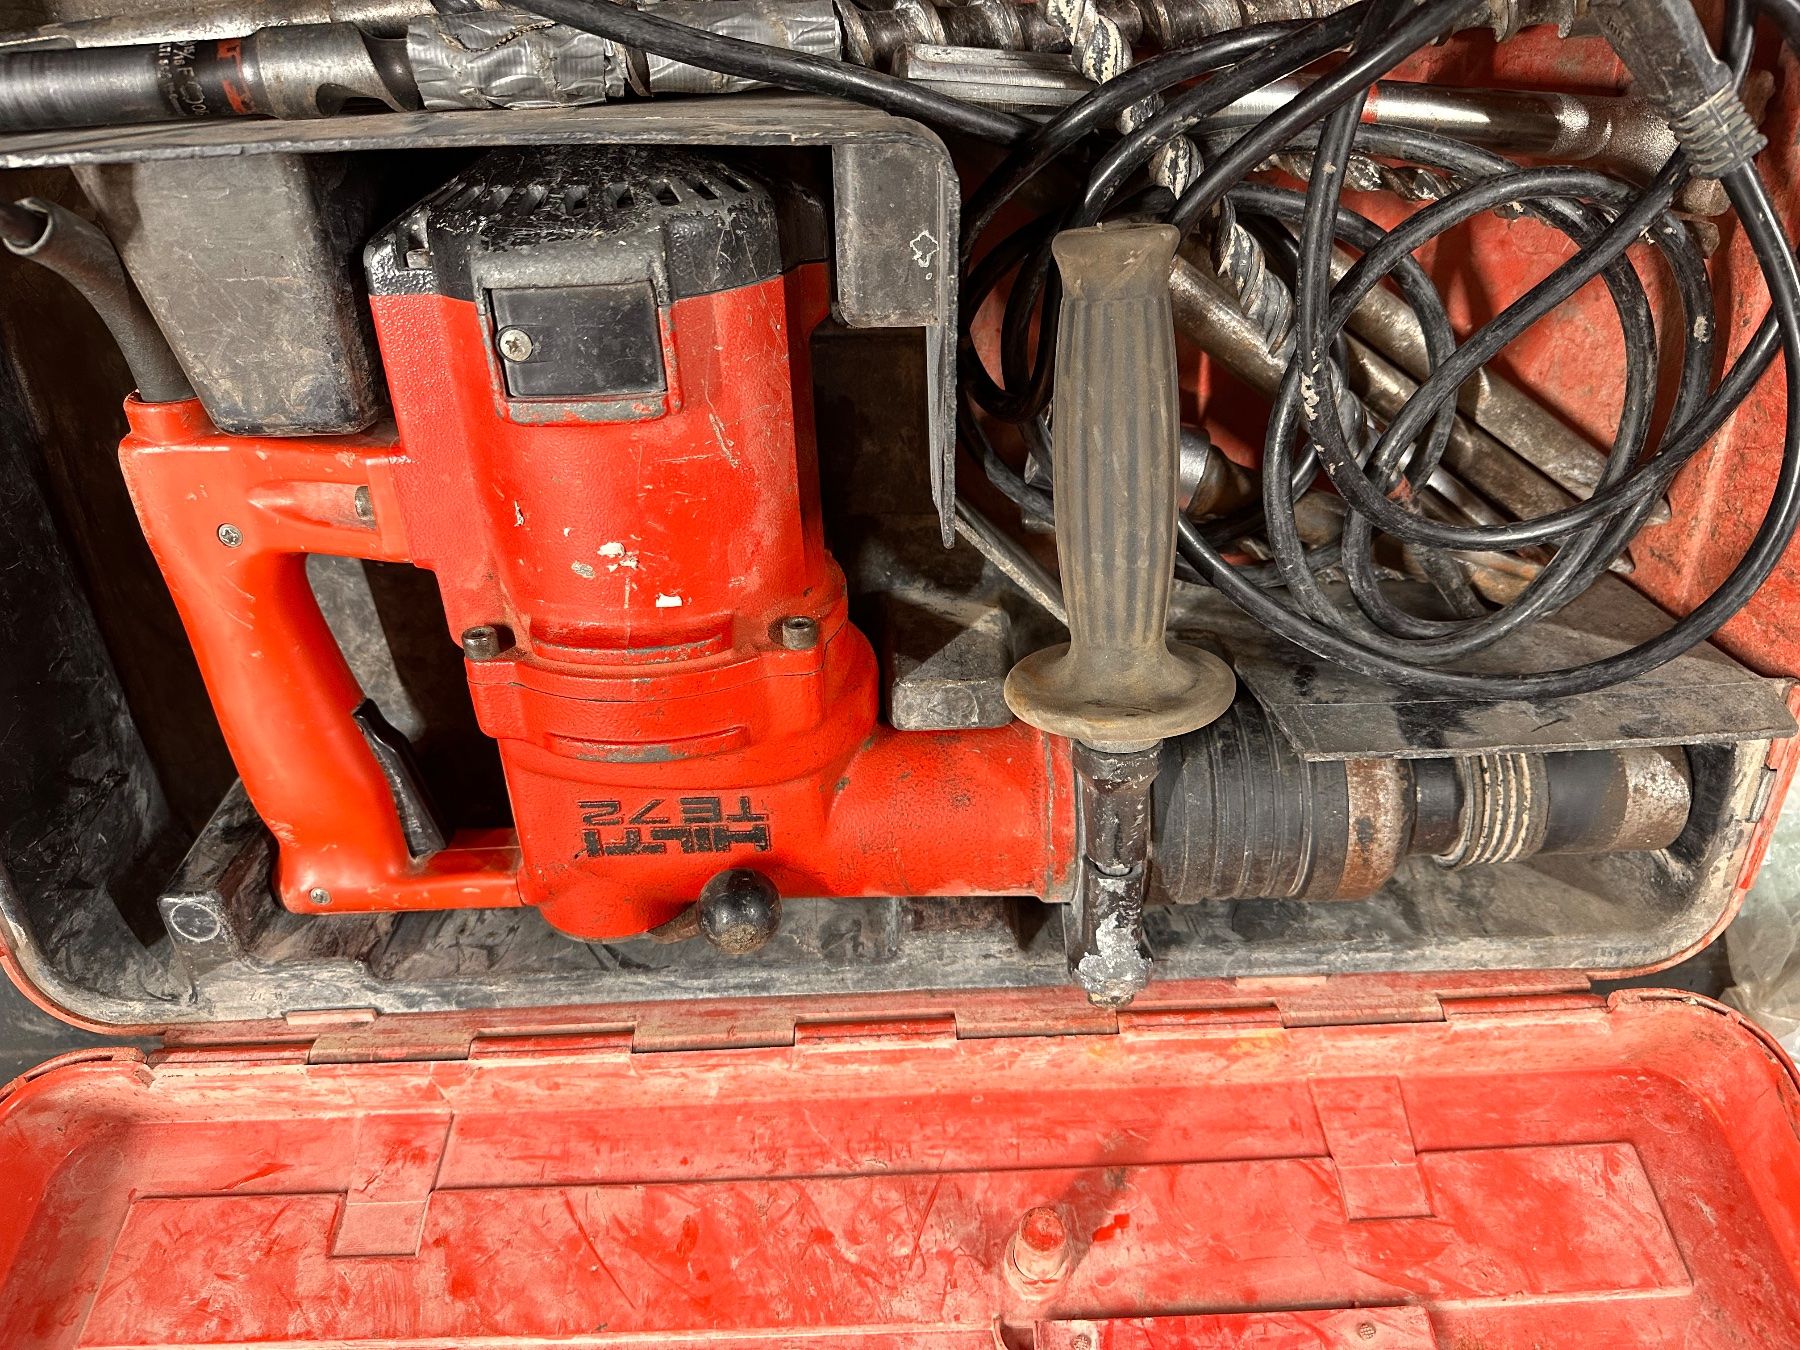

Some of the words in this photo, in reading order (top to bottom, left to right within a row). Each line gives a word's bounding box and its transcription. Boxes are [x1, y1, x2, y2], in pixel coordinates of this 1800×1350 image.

[577, 800, 669, 827] 72
[681, 797, 769, 824] TE
[582, 827, 771, 858] HILTI
